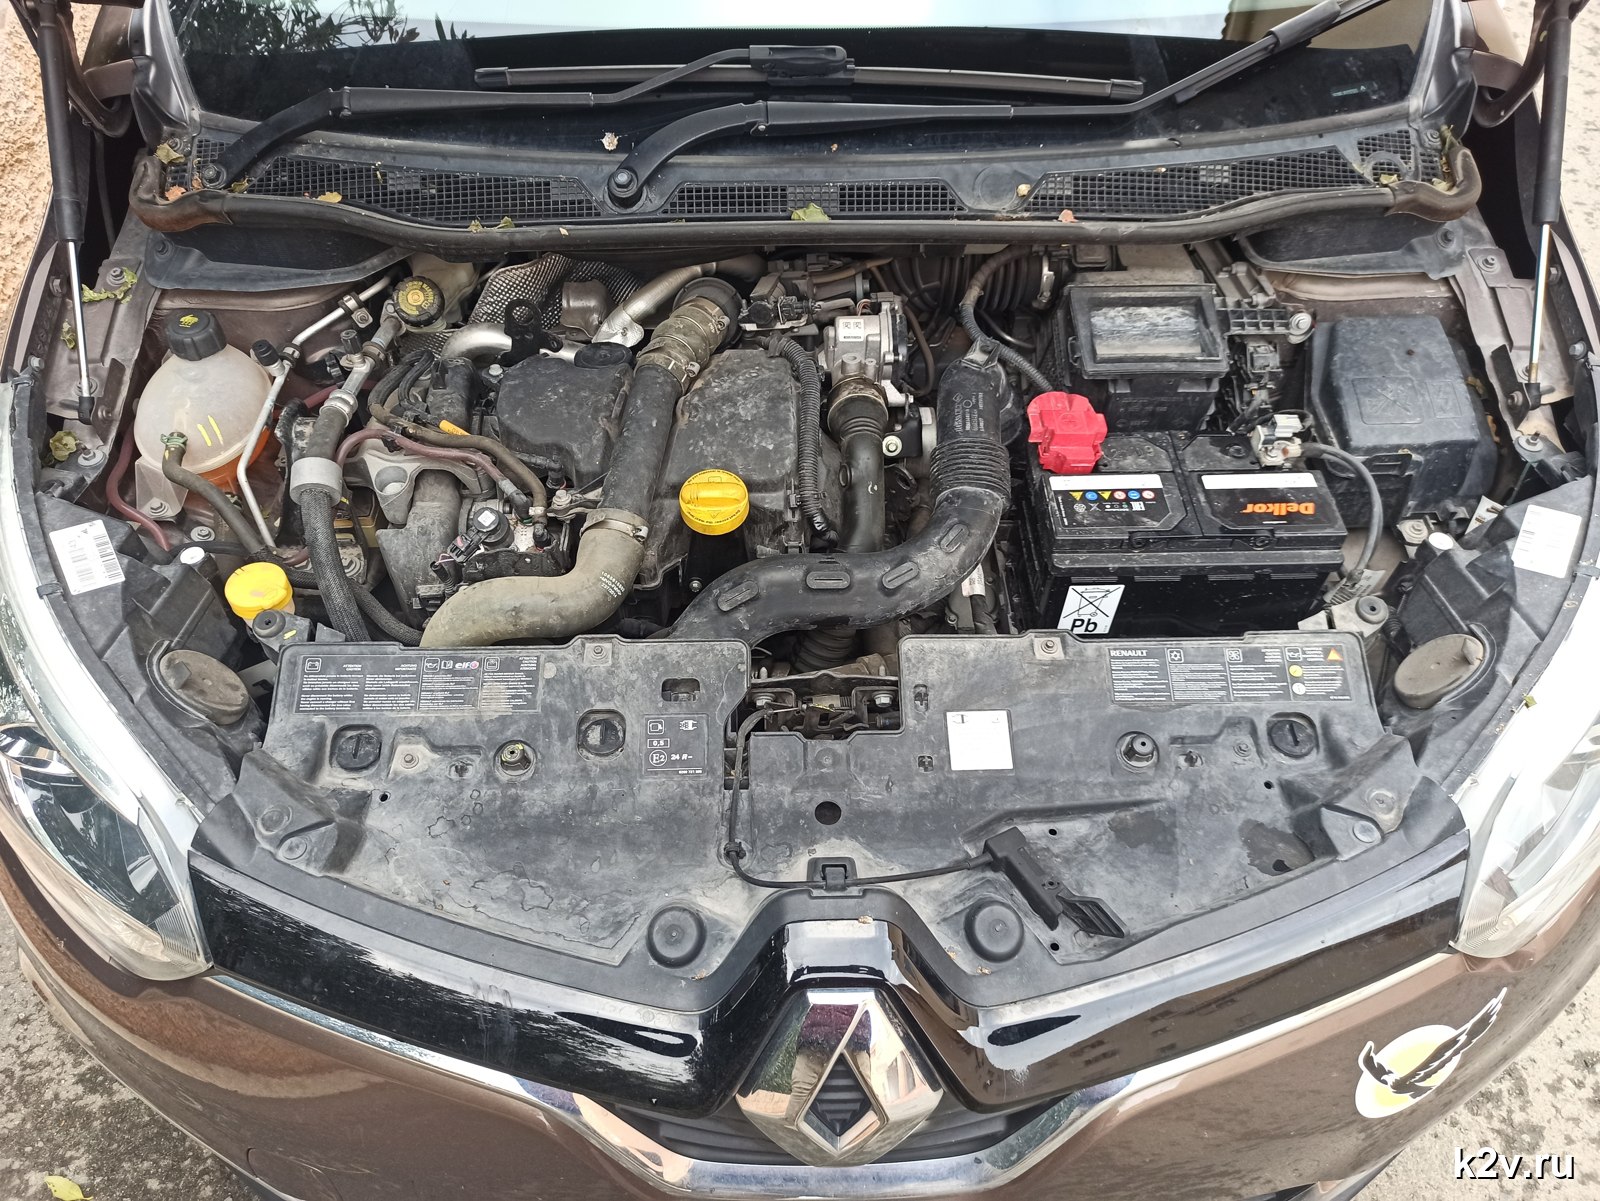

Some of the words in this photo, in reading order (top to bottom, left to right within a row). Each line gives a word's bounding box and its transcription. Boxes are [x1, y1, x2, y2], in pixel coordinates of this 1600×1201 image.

[1241, 502, 1315, 515] Delkor
[1070, 618, 1098, 633] Pb
[1110, 649, 1148, 657] RENAULT
[454, 660, 471, 669] elf
[652, 753, 666, 764] E2
[671, 753, 680, 761] 24
